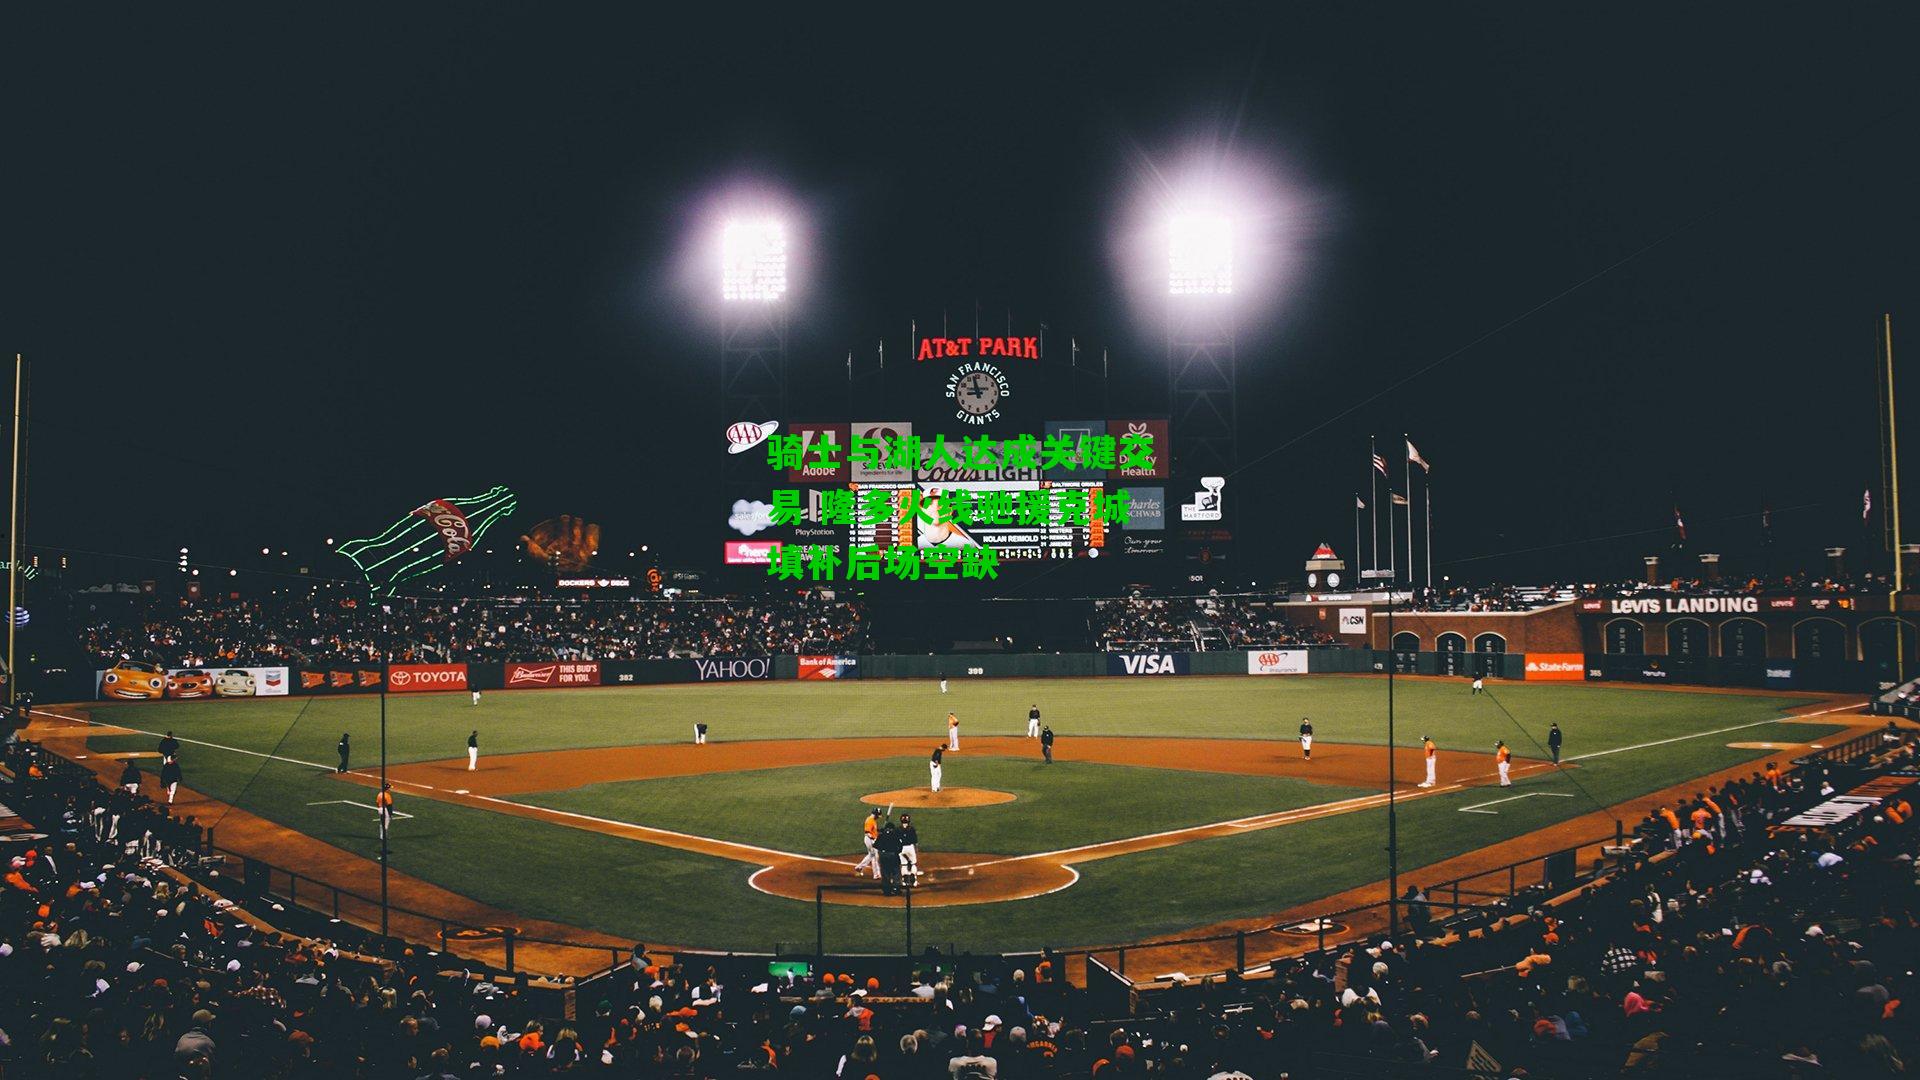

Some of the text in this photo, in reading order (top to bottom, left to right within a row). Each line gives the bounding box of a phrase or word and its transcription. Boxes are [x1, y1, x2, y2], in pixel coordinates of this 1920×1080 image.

[918, 337, 1038, 360] AT&T PARK
[946, 362, 1010, 398] SAN FRANCISCO
[956, 409, 1000, 424] GIANTS
[1126, 499, 1160, 510] harles
[1666, 597, 1758, 612] LANDING
[1350, 616, 1363, 625] CSN
[800, 658, 856, 666] Bank of America
[1119, 655, 1175, 675] VISA
[559, 664, 598, 673] THIS BUD'S
[696, 659, 770, 680] YAHOO!
[413, 671, 467, 683] TOYOTA
[514, 671, 551, 679] Budweiser
[574, 674, 590, 682] YOU.
